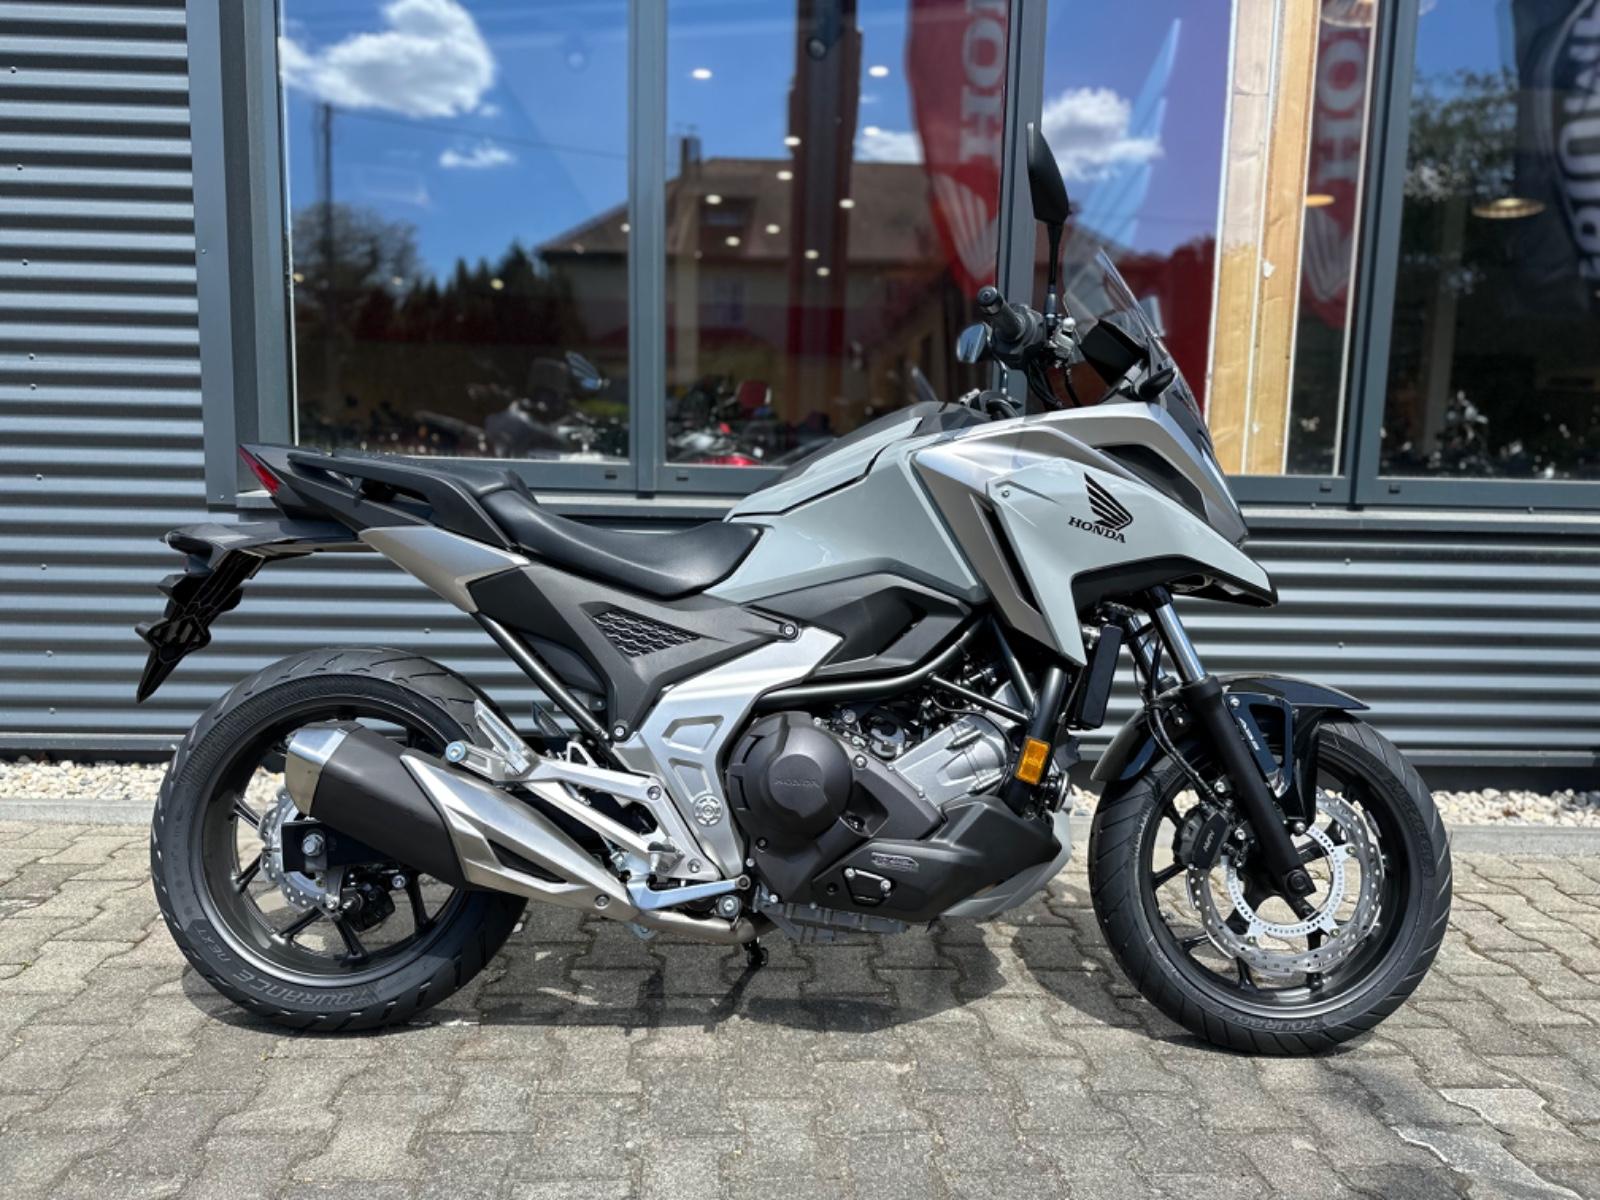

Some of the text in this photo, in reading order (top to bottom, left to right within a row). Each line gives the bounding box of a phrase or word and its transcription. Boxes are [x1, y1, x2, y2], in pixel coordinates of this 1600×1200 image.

[960, 0, 1005, 165] HO
[1316, 27, 1366, 187] HO
[1067, 515, 1126, 544] HONDA
[232, 967, 378, 1007] TOURANCE
